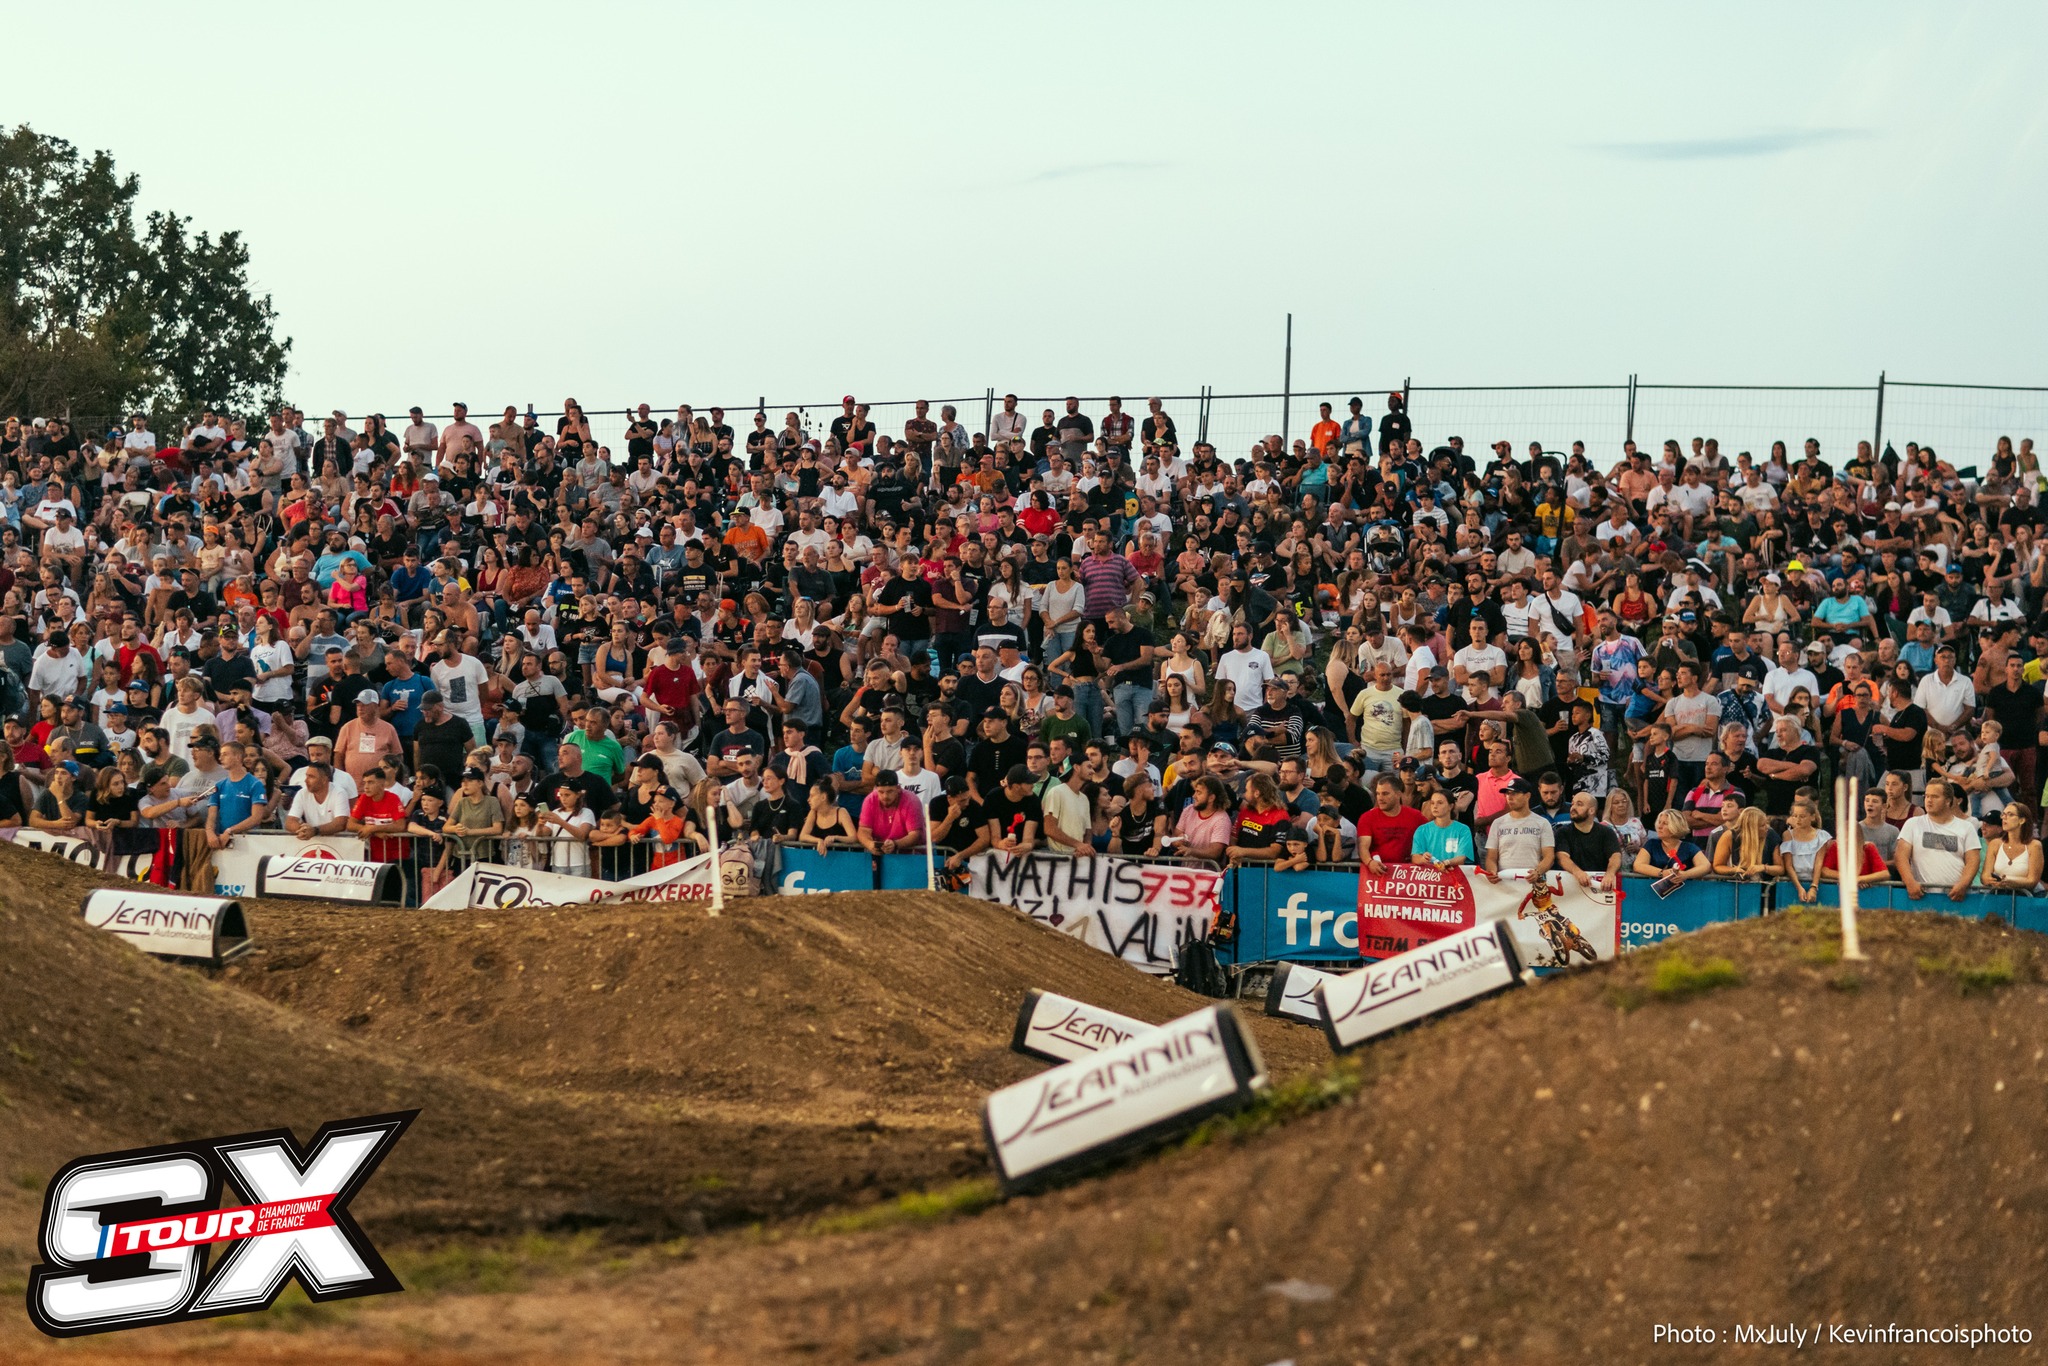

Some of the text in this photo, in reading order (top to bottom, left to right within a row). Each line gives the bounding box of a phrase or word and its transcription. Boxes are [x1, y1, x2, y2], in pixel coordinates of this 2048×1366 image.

[904, 784, 922, 793] NIKE
[1242, 820, 1263, 832] GEICO
[1513, 827, 1519, 835] &
[1520, 827, 1541, 836] JONES
[1392, 864, 1407, 881] Tes
[324, 875, 374, 888] Automobiles
[1141, 871, 1217, 908] 737
[1363, 903, 1463, 924] HAUT-MARNAIS
[153, 928, 212, 941] Automobiles
